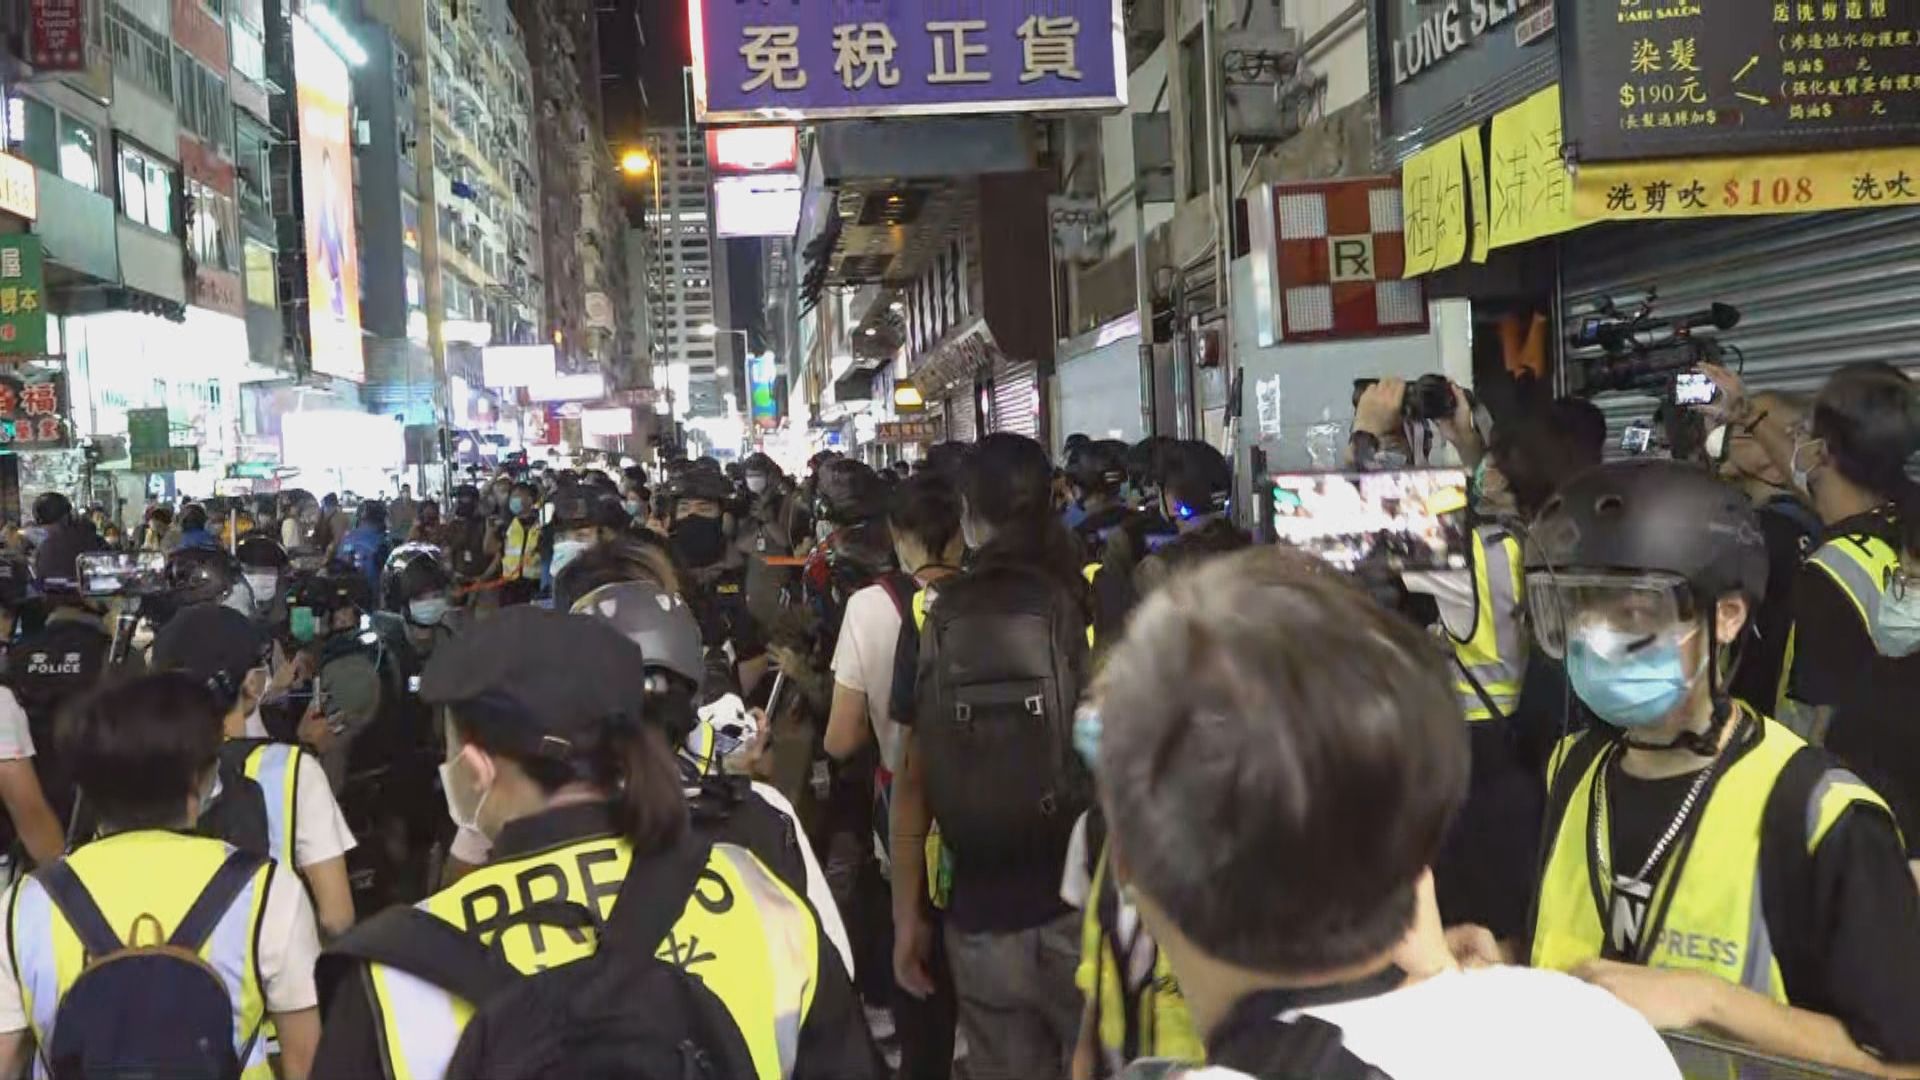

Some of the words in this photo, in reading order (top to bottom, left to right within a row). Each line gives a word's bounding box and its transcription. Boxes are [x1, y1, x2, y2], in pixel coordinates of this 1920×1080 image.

[1656, 5, 1701, 20] SALON
[1393, 0, 1466, 85] LUNG
[1630, 37, 1702, 75] 染髮
[1619, 75, 1707, 108] $190元
[1606, 179, 1709, 213] 洗剪吹
[1723, 177, 1814, 207] $108
[1853, 169, 1917, 201] 洗吹
[27, 663, 81, 673] POLICE
[1658, 931, 1738, 966] PRESS
